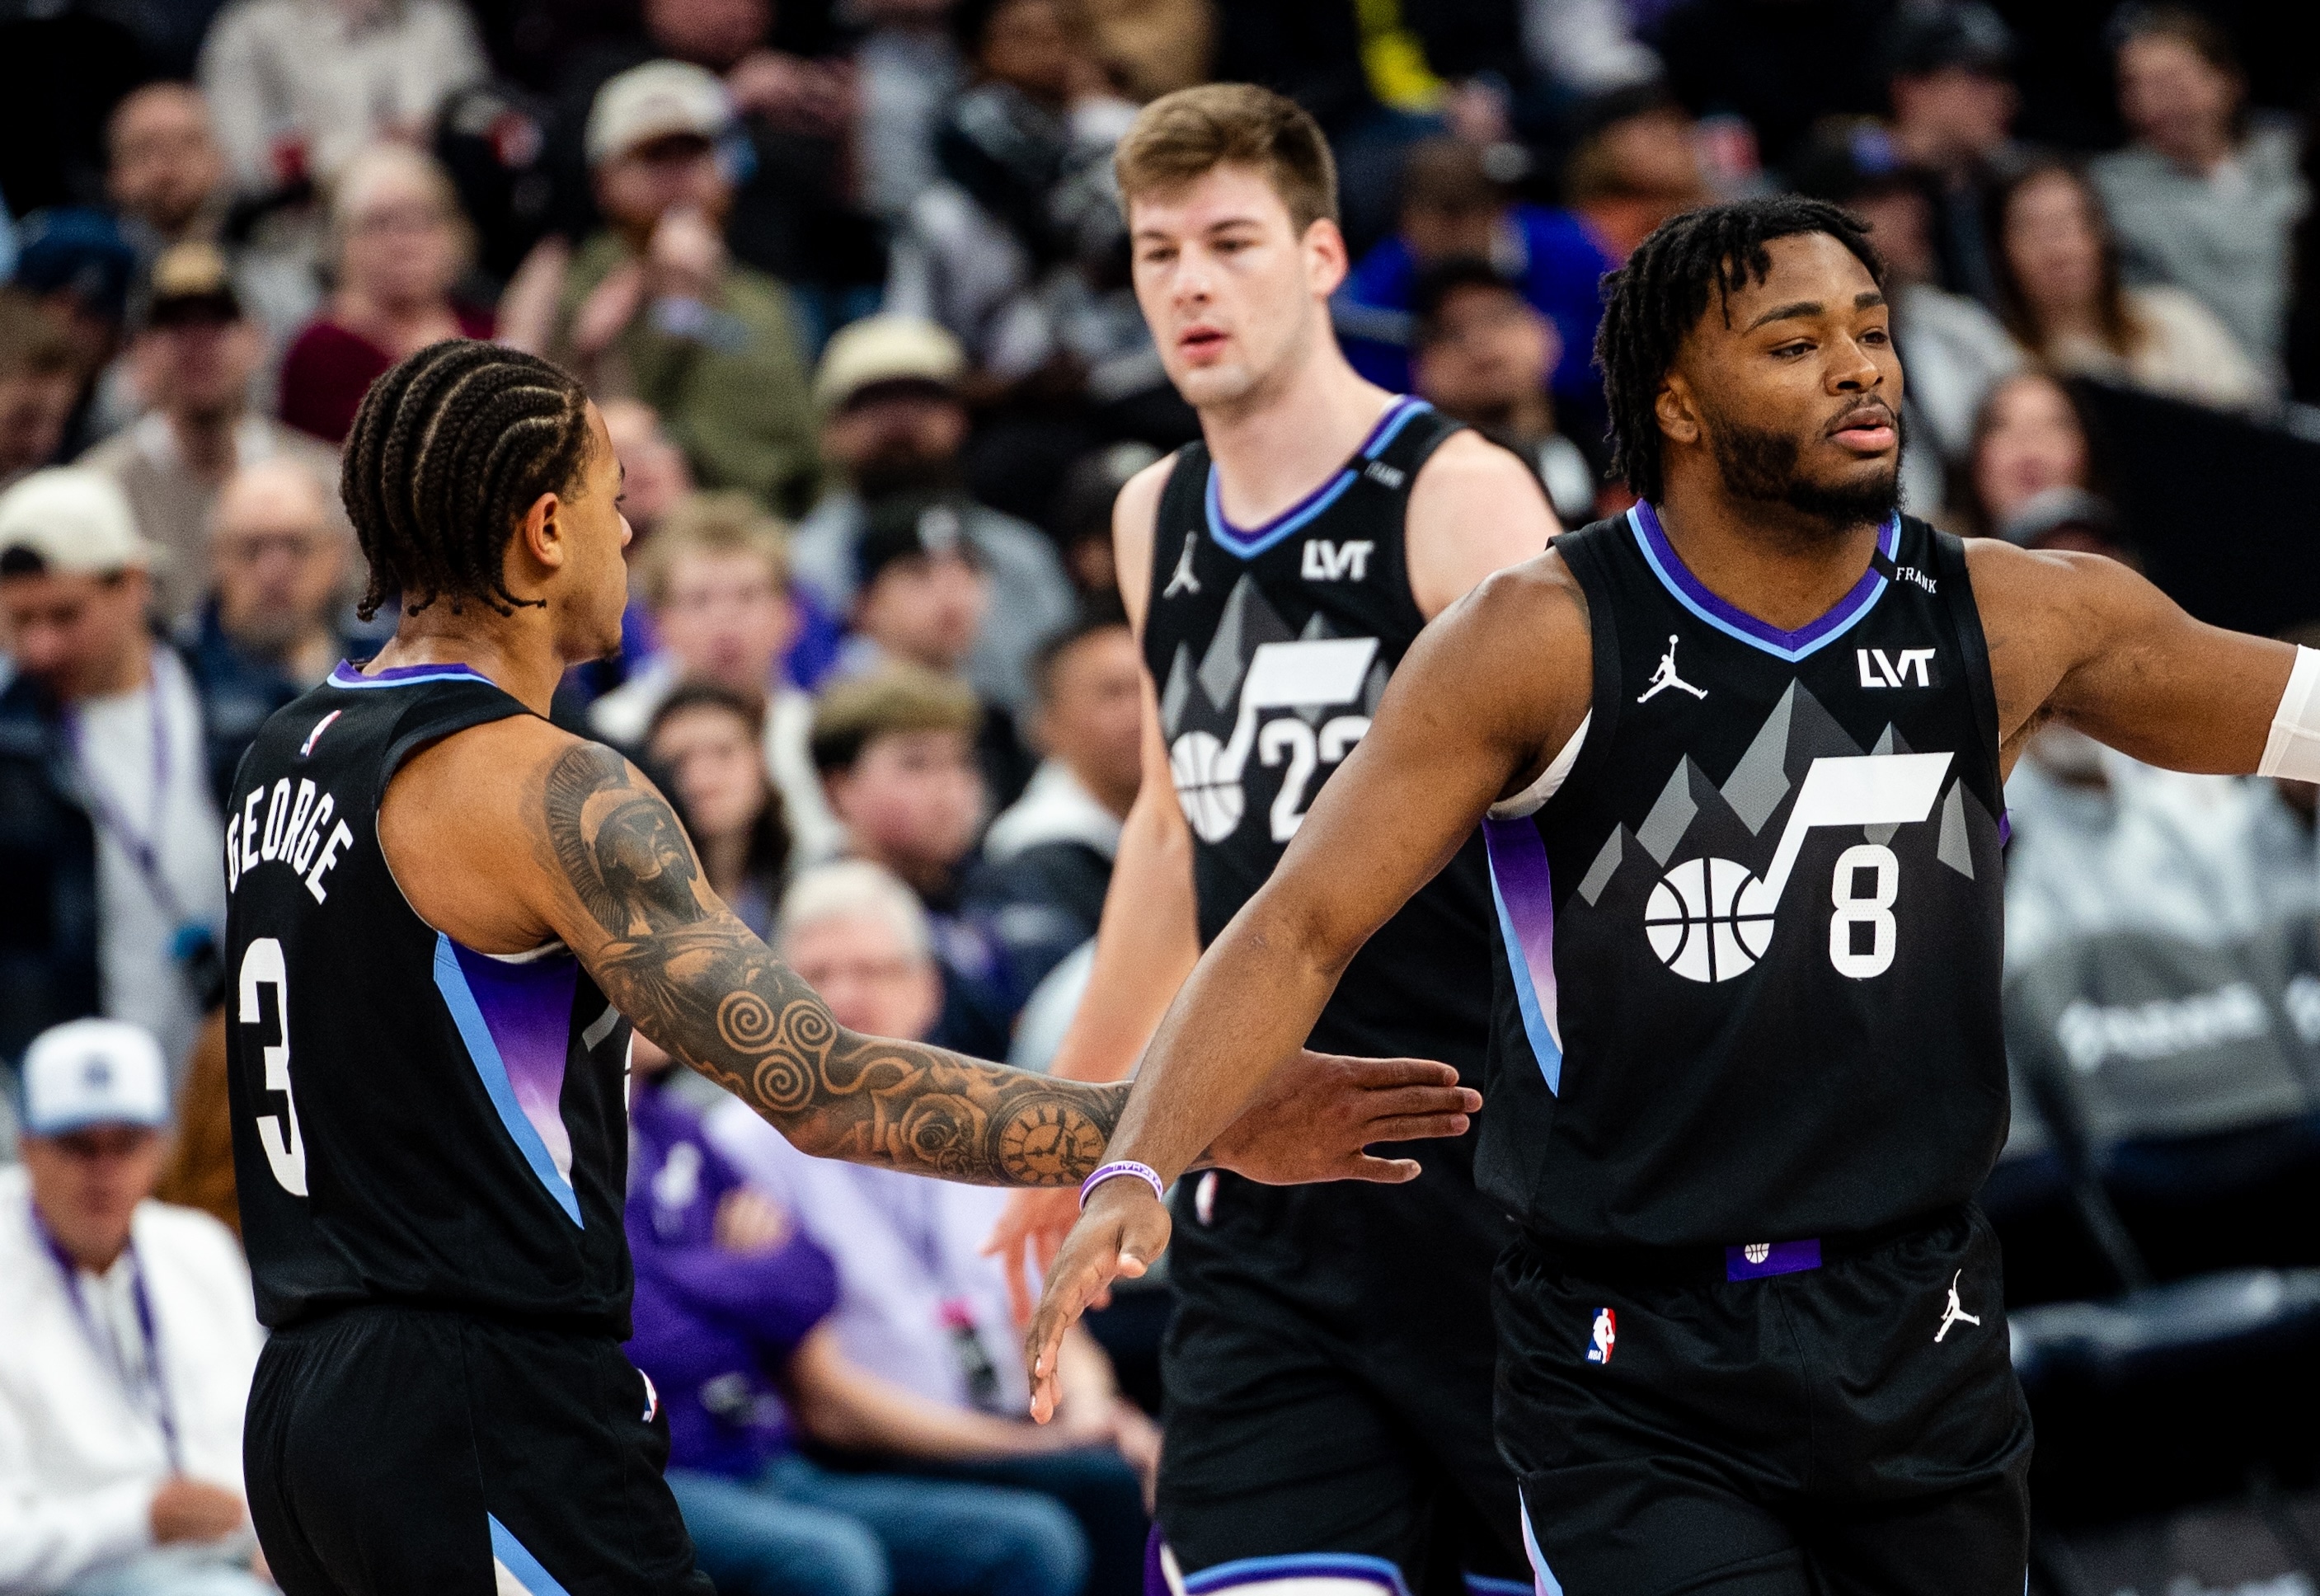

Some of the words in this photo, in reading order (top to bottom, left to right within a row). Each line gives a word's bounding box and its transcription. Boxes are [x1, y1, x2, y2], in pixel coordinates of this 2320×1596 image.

[1301, 539, 1374, 580] LVT
[1895, 566, 1937, 594] FRANK
[1857, 648, 1936, 688] LVT
[227, 777, 354, 905] GEORGE
[1829, 844, 1899, 979] 8
[239, 937, 308, 1197] 3
[1587, 1349, 1602, 1361] NBA
